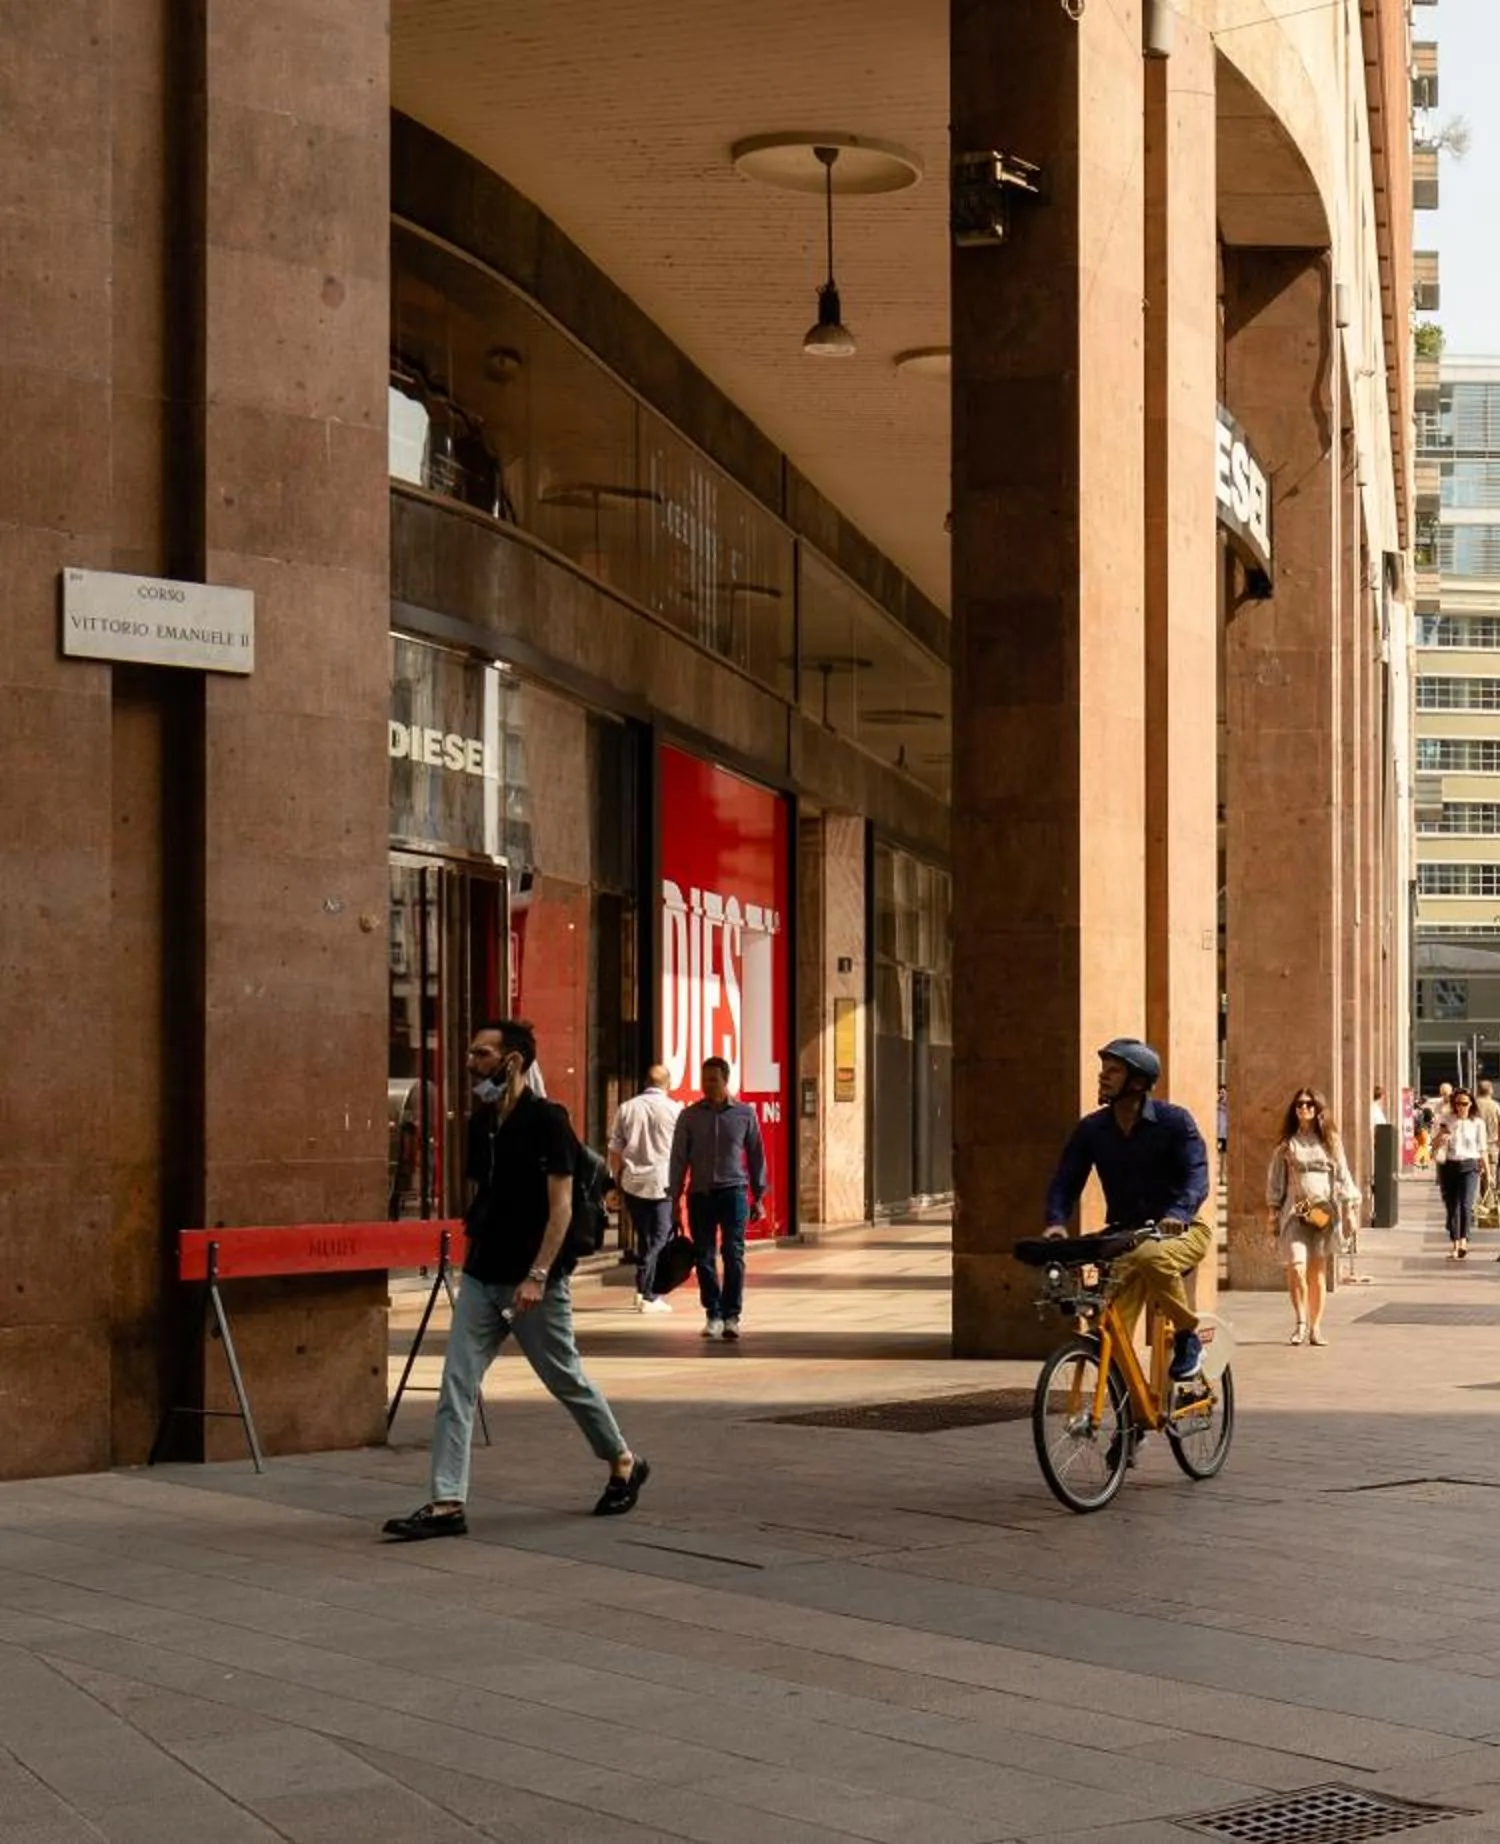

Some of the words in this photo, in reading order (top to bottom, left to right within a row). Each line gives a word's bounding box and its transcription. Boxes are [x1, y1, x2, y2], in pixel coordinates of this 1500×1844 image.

[137, 585, 186, 603] CORSO
[71, 616, 149, 637] VITTORIO
[157, 624, 234, 647] EMANUELE
[241, 634, 249, 647] II
